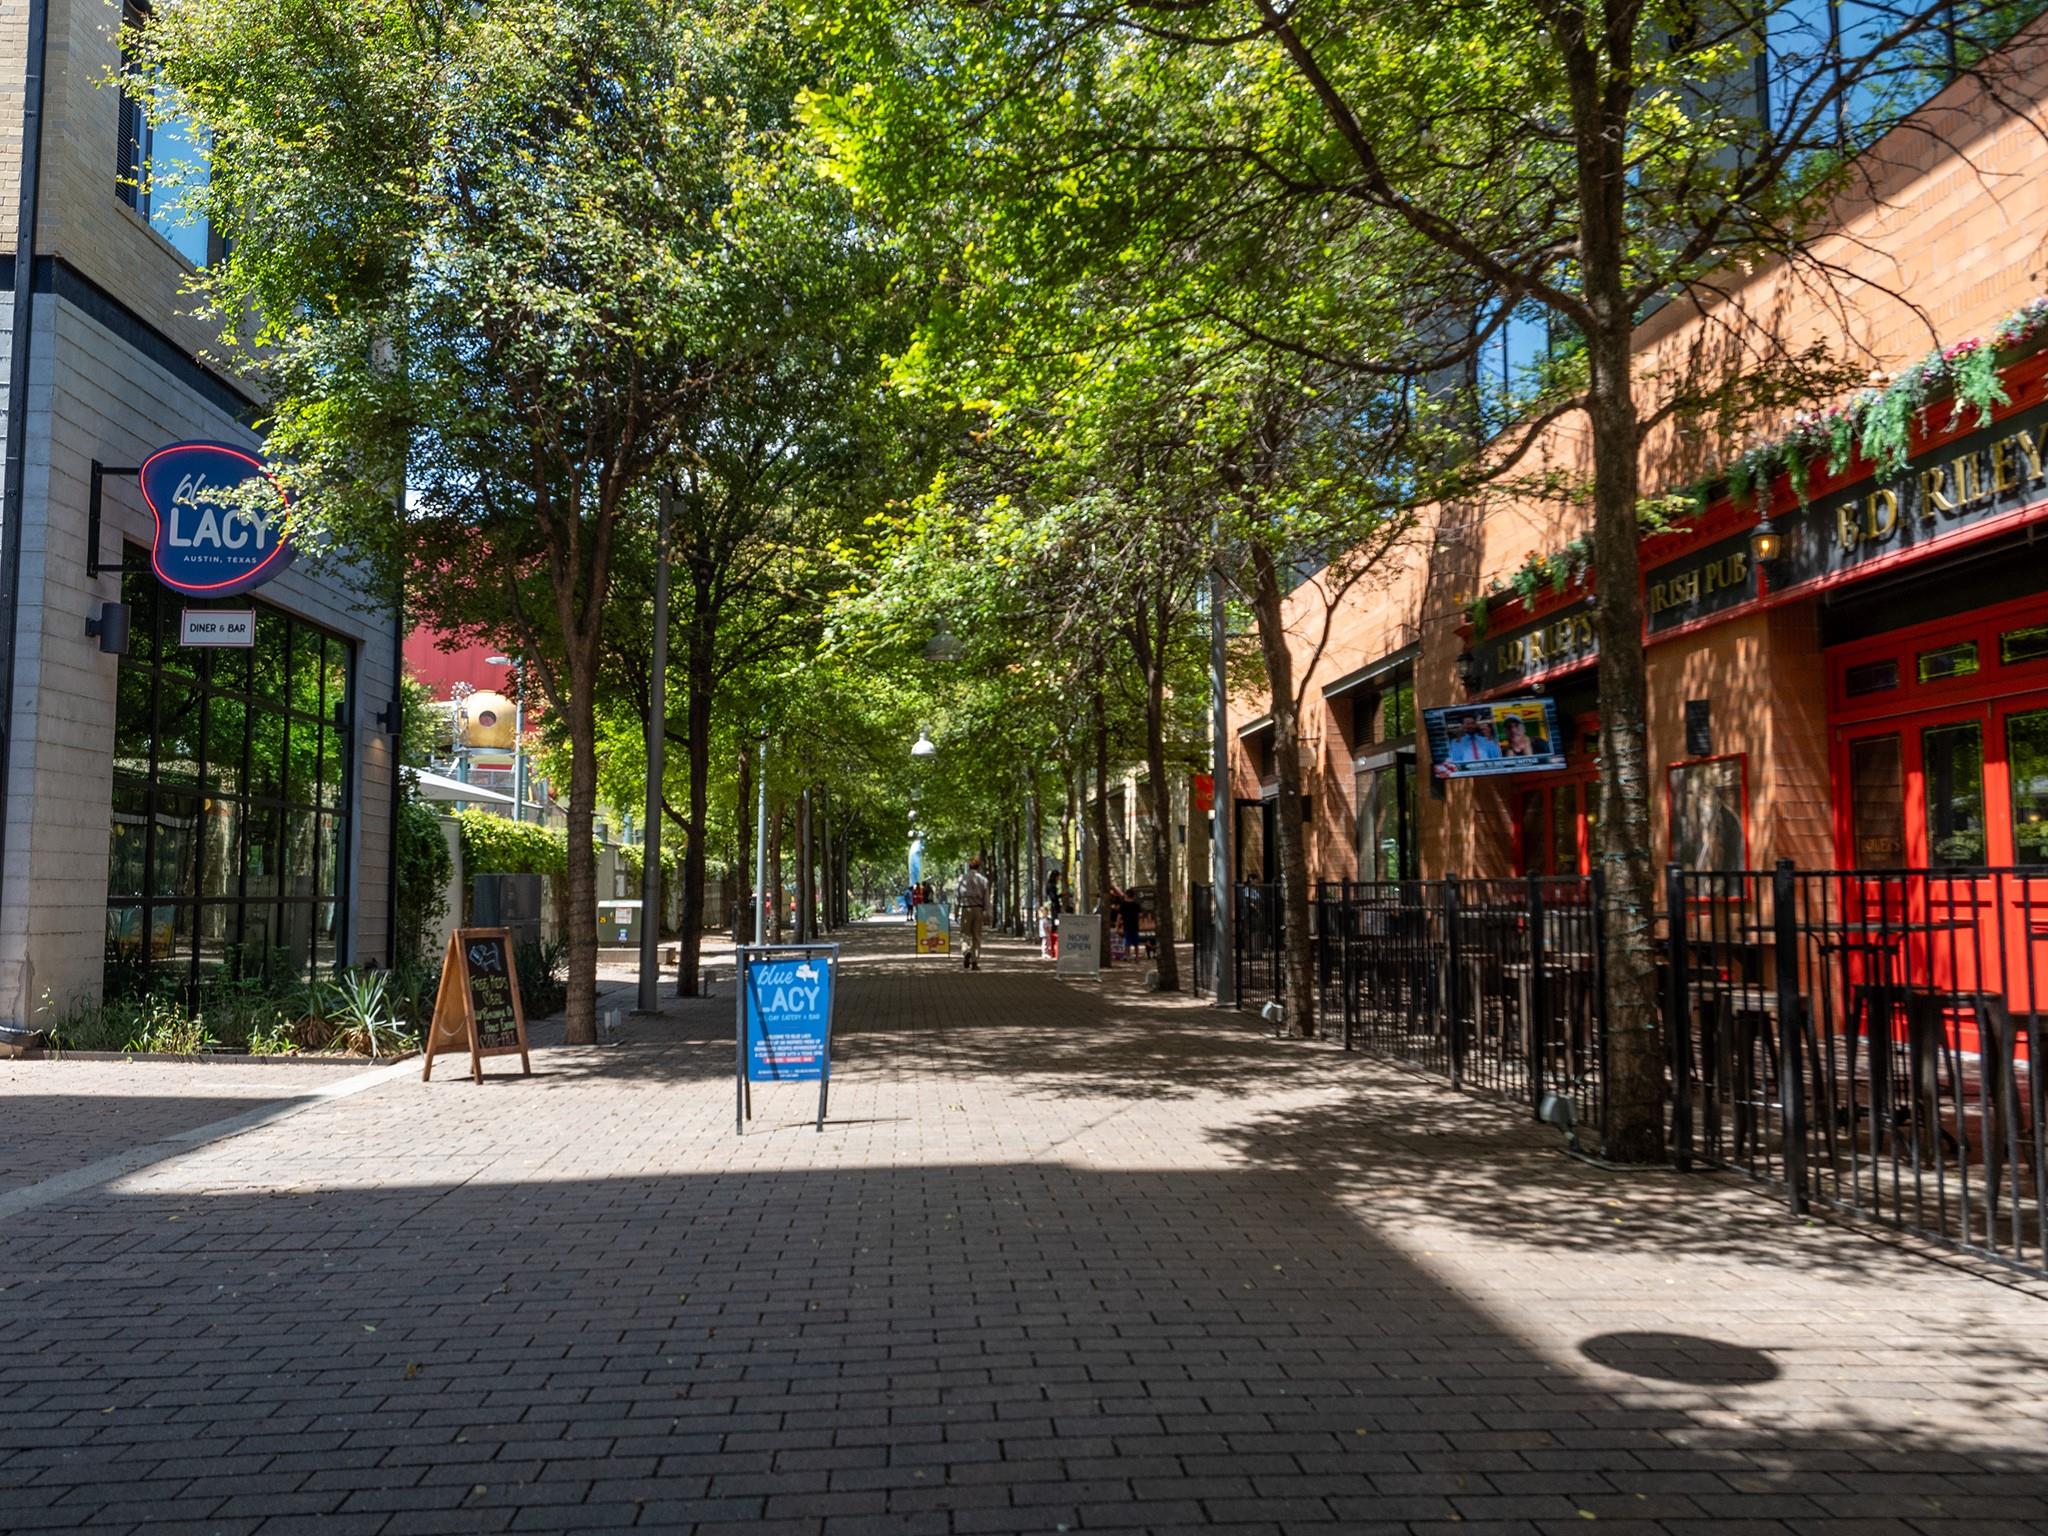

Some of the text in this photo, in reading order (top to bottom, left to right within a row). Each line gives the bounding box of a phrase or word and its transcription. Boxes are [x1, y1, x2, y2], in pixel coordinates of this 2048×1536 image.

[169, 506, 275, 550] LACY
[183, 555, 257, 564] AUSTIN, TEXAS
[1704, 552, 1747, 593] PUB
[189, 623, 216, 633] DINER
[227, 623, 247, 633] BAR
[1068, 933, 1090, 942] NOW
[1066, 942, 1091, 951] OPEN
[757, 965, 794, 985] blue
[757, 986, 820, 1013] LACY
